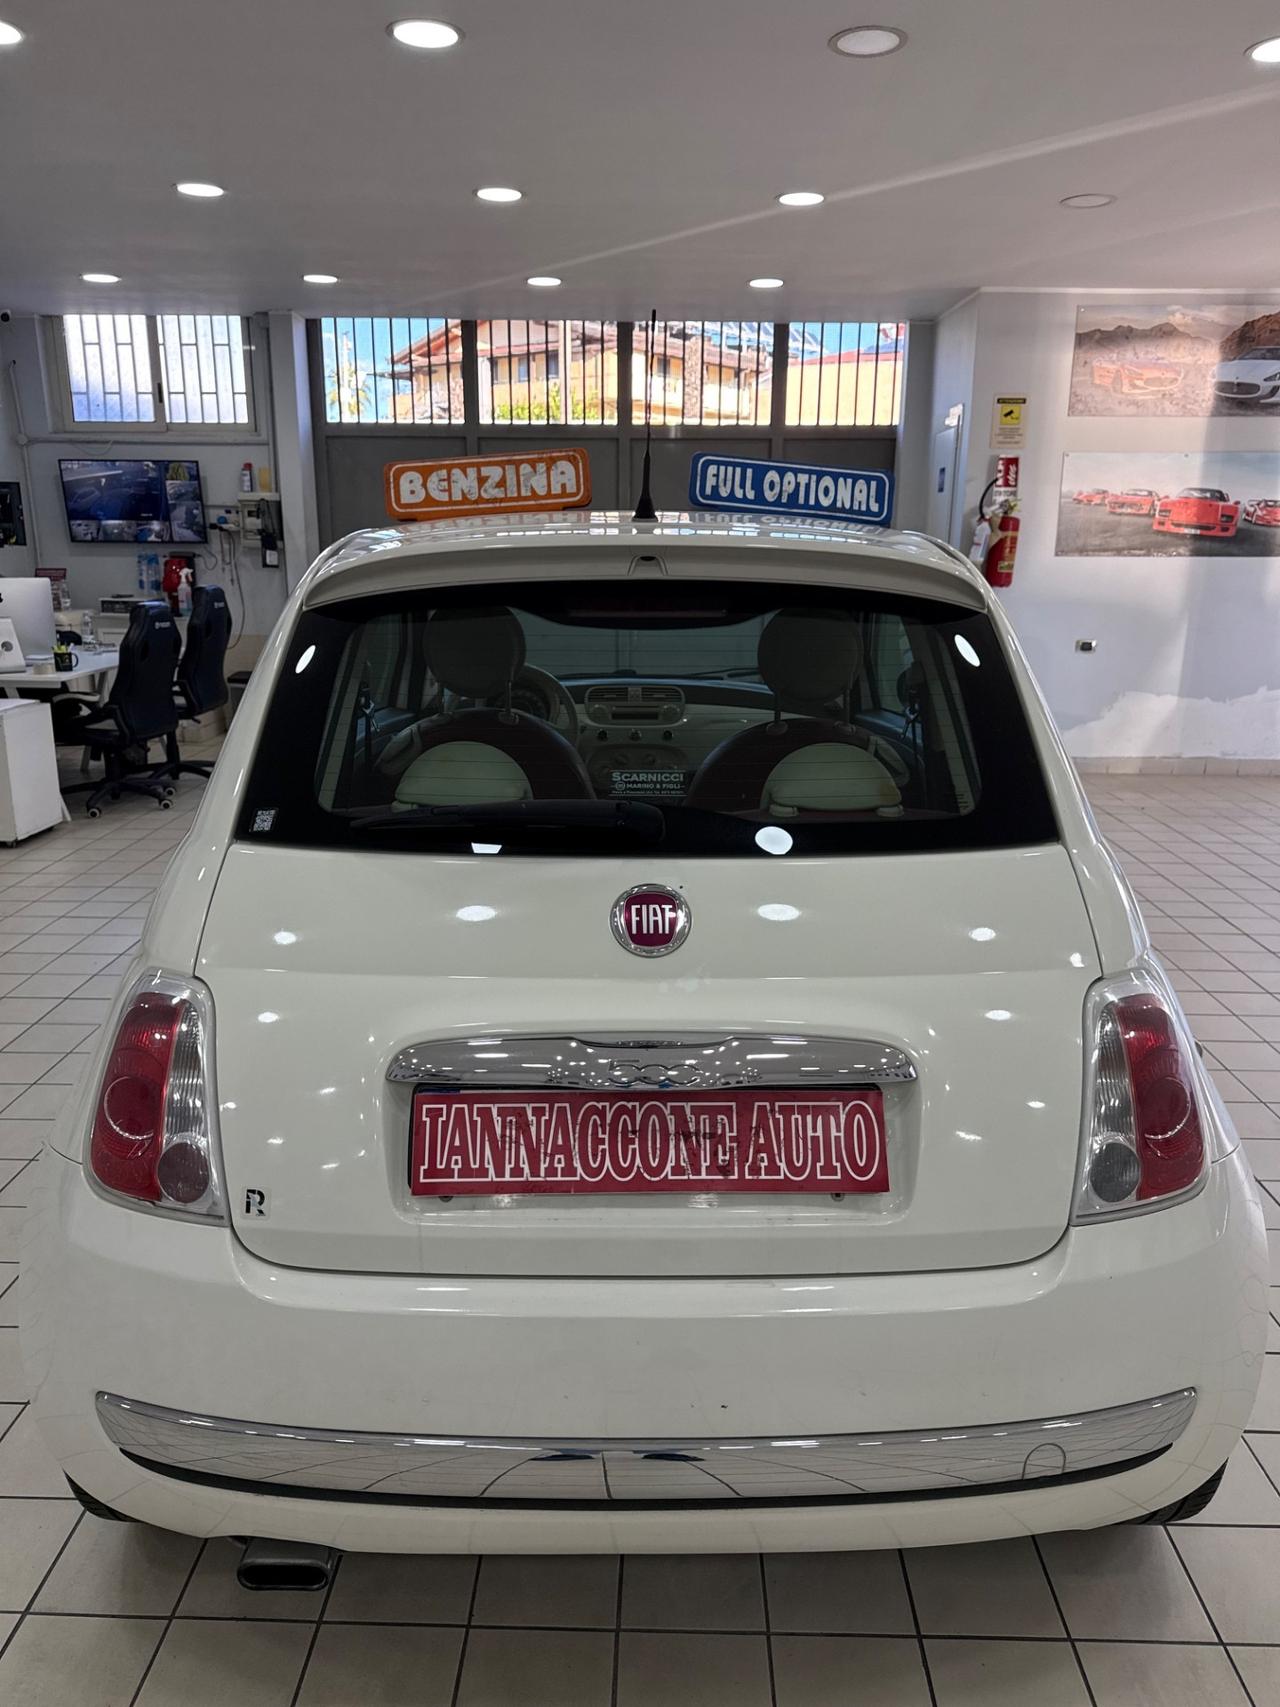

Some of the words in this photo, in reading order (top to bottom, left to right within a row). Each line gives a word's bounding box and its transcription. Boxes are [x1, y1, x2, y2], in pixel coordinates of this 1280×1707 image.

[399, 460, 577, 504] BENZINA
[705, 464, 755, 500] FULL
[762, 470, 879, 512] OPTIONAL
[612, 773, 684, 782] SCARNICCI
[631, 904, 674, 934] FIAT
[419, 1101, 738, 1183] IANNACCONE
[745, 1100, 881, 1180] AUTO
